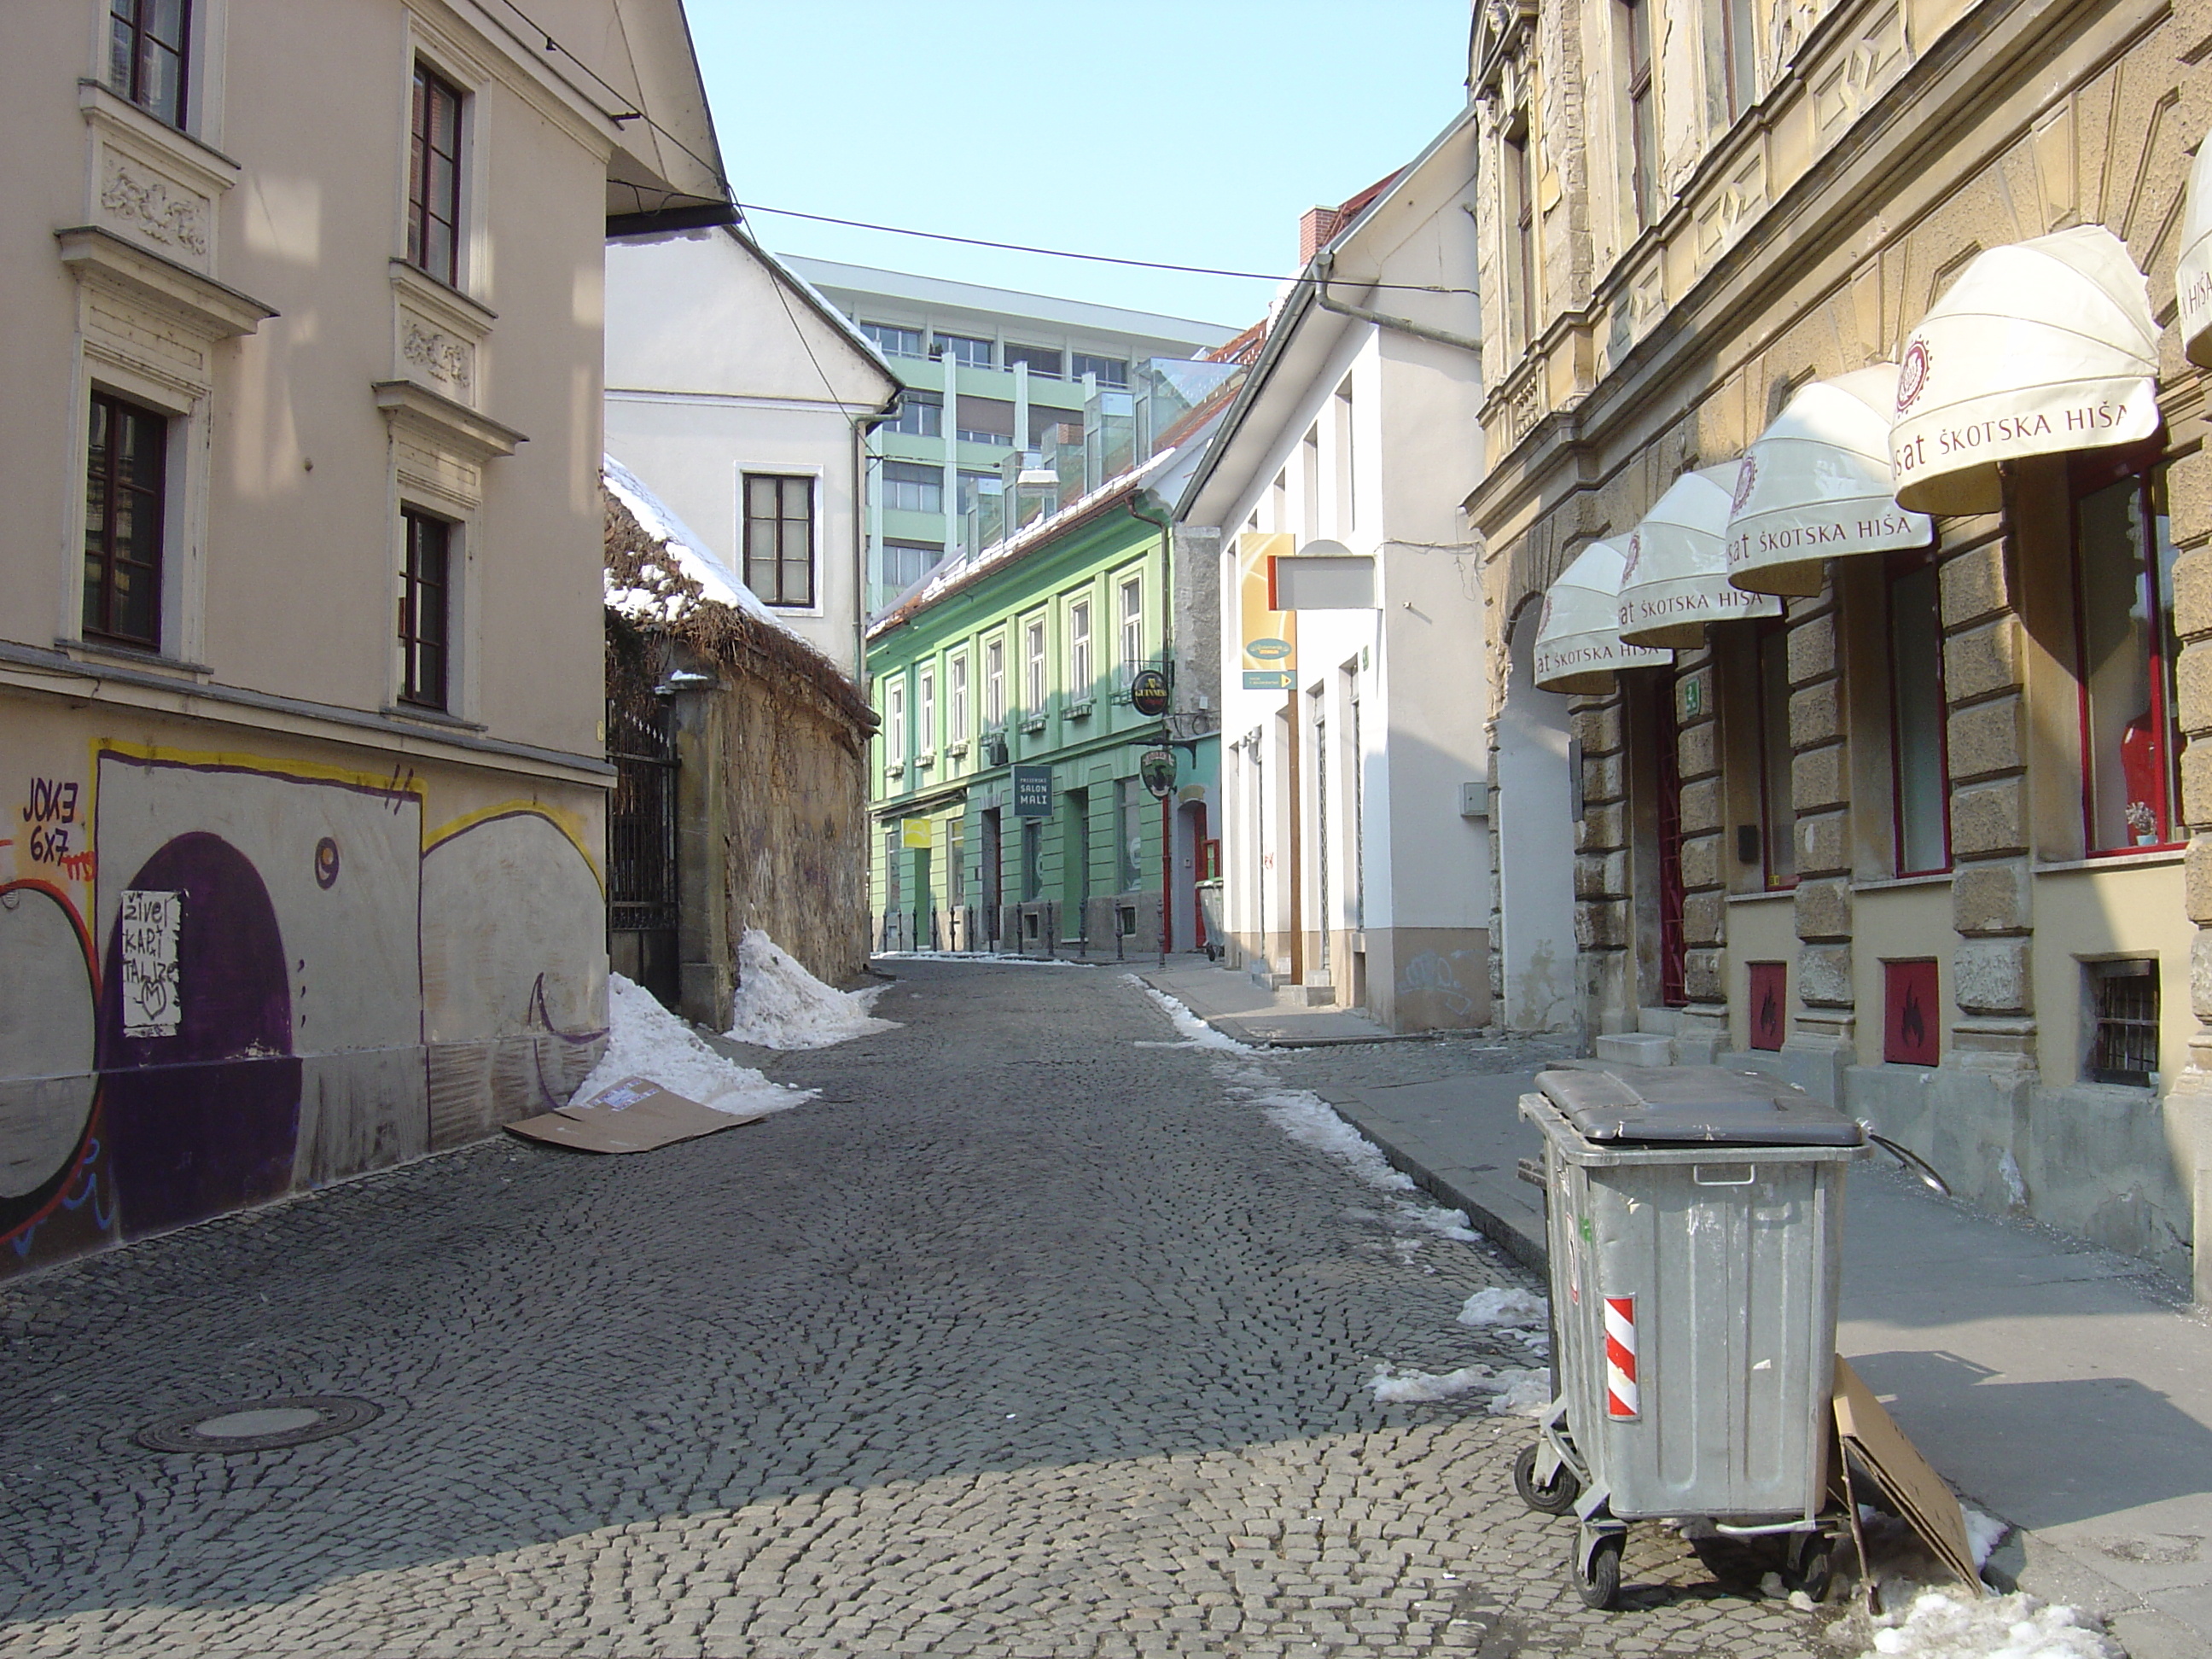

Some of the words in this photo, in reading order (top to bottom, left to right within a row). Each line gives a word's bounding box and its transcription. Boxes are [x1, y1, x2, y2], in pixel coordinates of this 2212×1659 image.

[1939, 413, 2052, 455] ŠKOTSKA
[2066, 400, 2128, 431] HIŠA
[1759, 523, 1847, 553] ŠKOTSKA
[1857, 514, 1912, 539] HIŠA
[1619, 602, 1634, 626] at
[1640, 593, 1709, 619] ŠKOTSKA
[1554, 646, 1613, 668] ŠKOTSKA
[1134, 688, 1167, 697] GUINNESS
[1020, 784, 1047, 793] SALON
[1020, 795, 1048, 805] MALI
